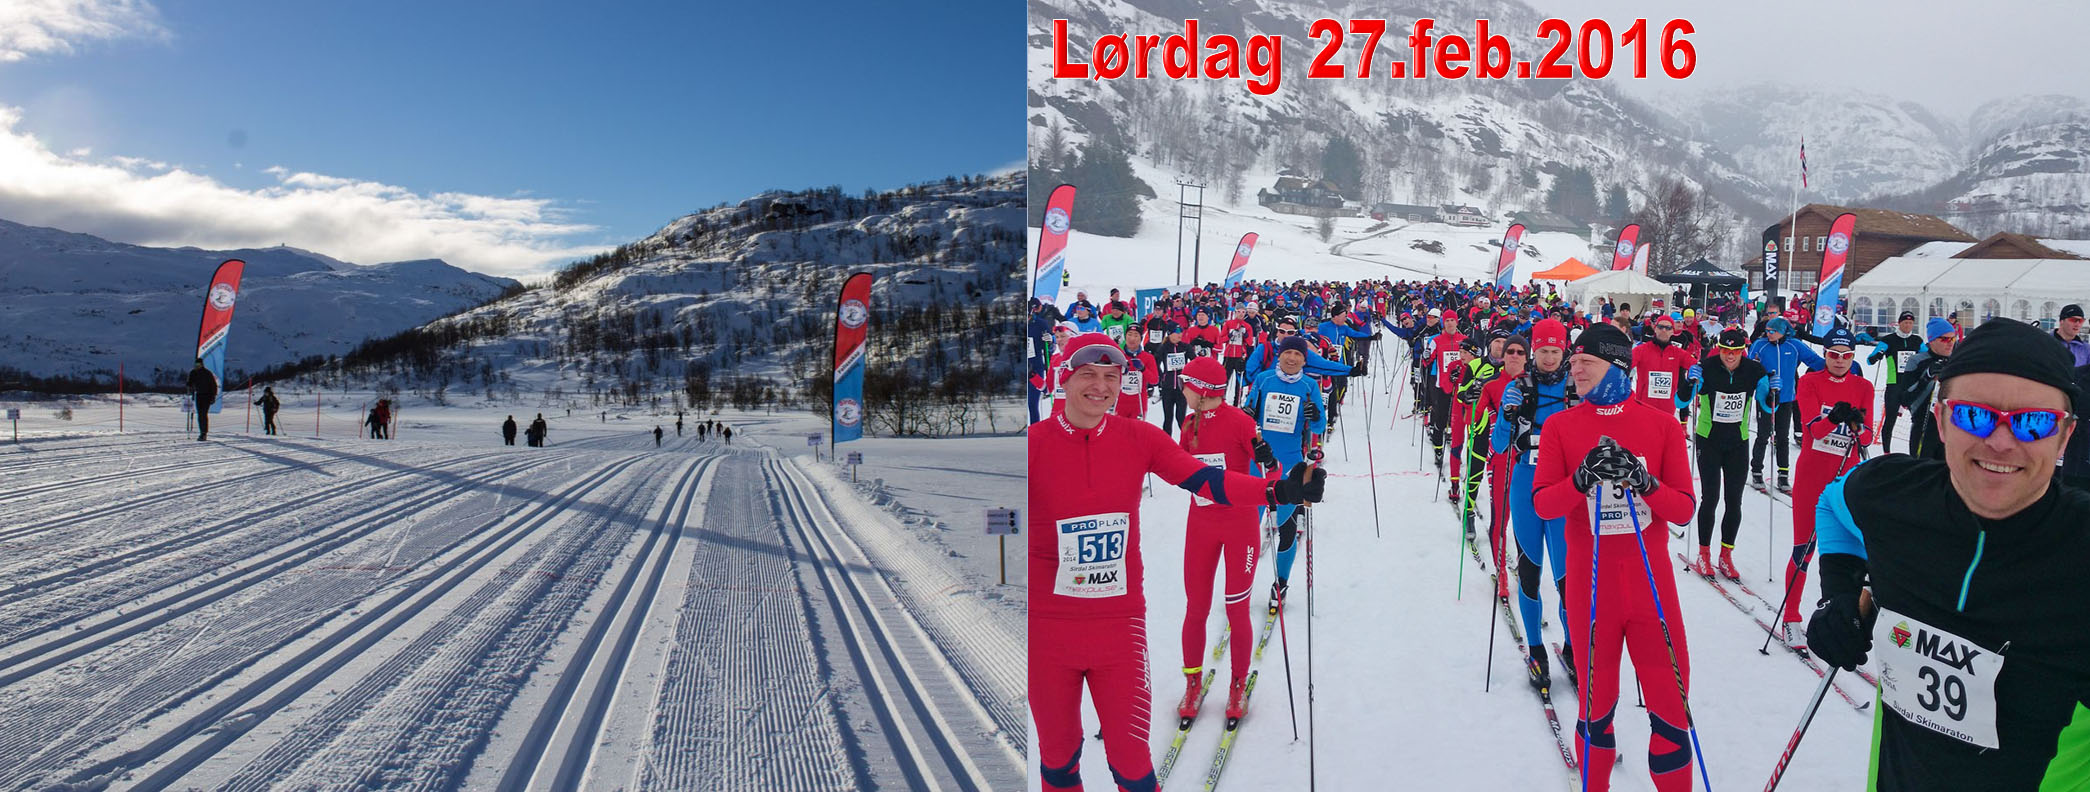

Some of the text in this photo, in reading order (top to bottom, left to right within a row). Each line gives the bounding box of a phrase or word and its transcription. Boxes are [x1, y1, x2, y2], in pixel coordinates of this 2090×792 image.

[1765, 252, 1777, 280] MAX
[1655, 377, 1671, 387] 522
[1278, 394, 1296, 403] MAX
[1723, 400, 1743, 410] 208
[1277, 402, 1292, 415] 50
[1830, 439, 1849, 449] MAX
[1071, 518, 1127, 531] PRO PLAN
[1082, 532, 1123, 562] 513
[1088, 570, 1118, 584] MAX
[1915, 628, 1982, 676] MAX
[1916, 665, 1968, 722] 39
[1893, 700, 1974, 743] Sirdal Skimaraton
